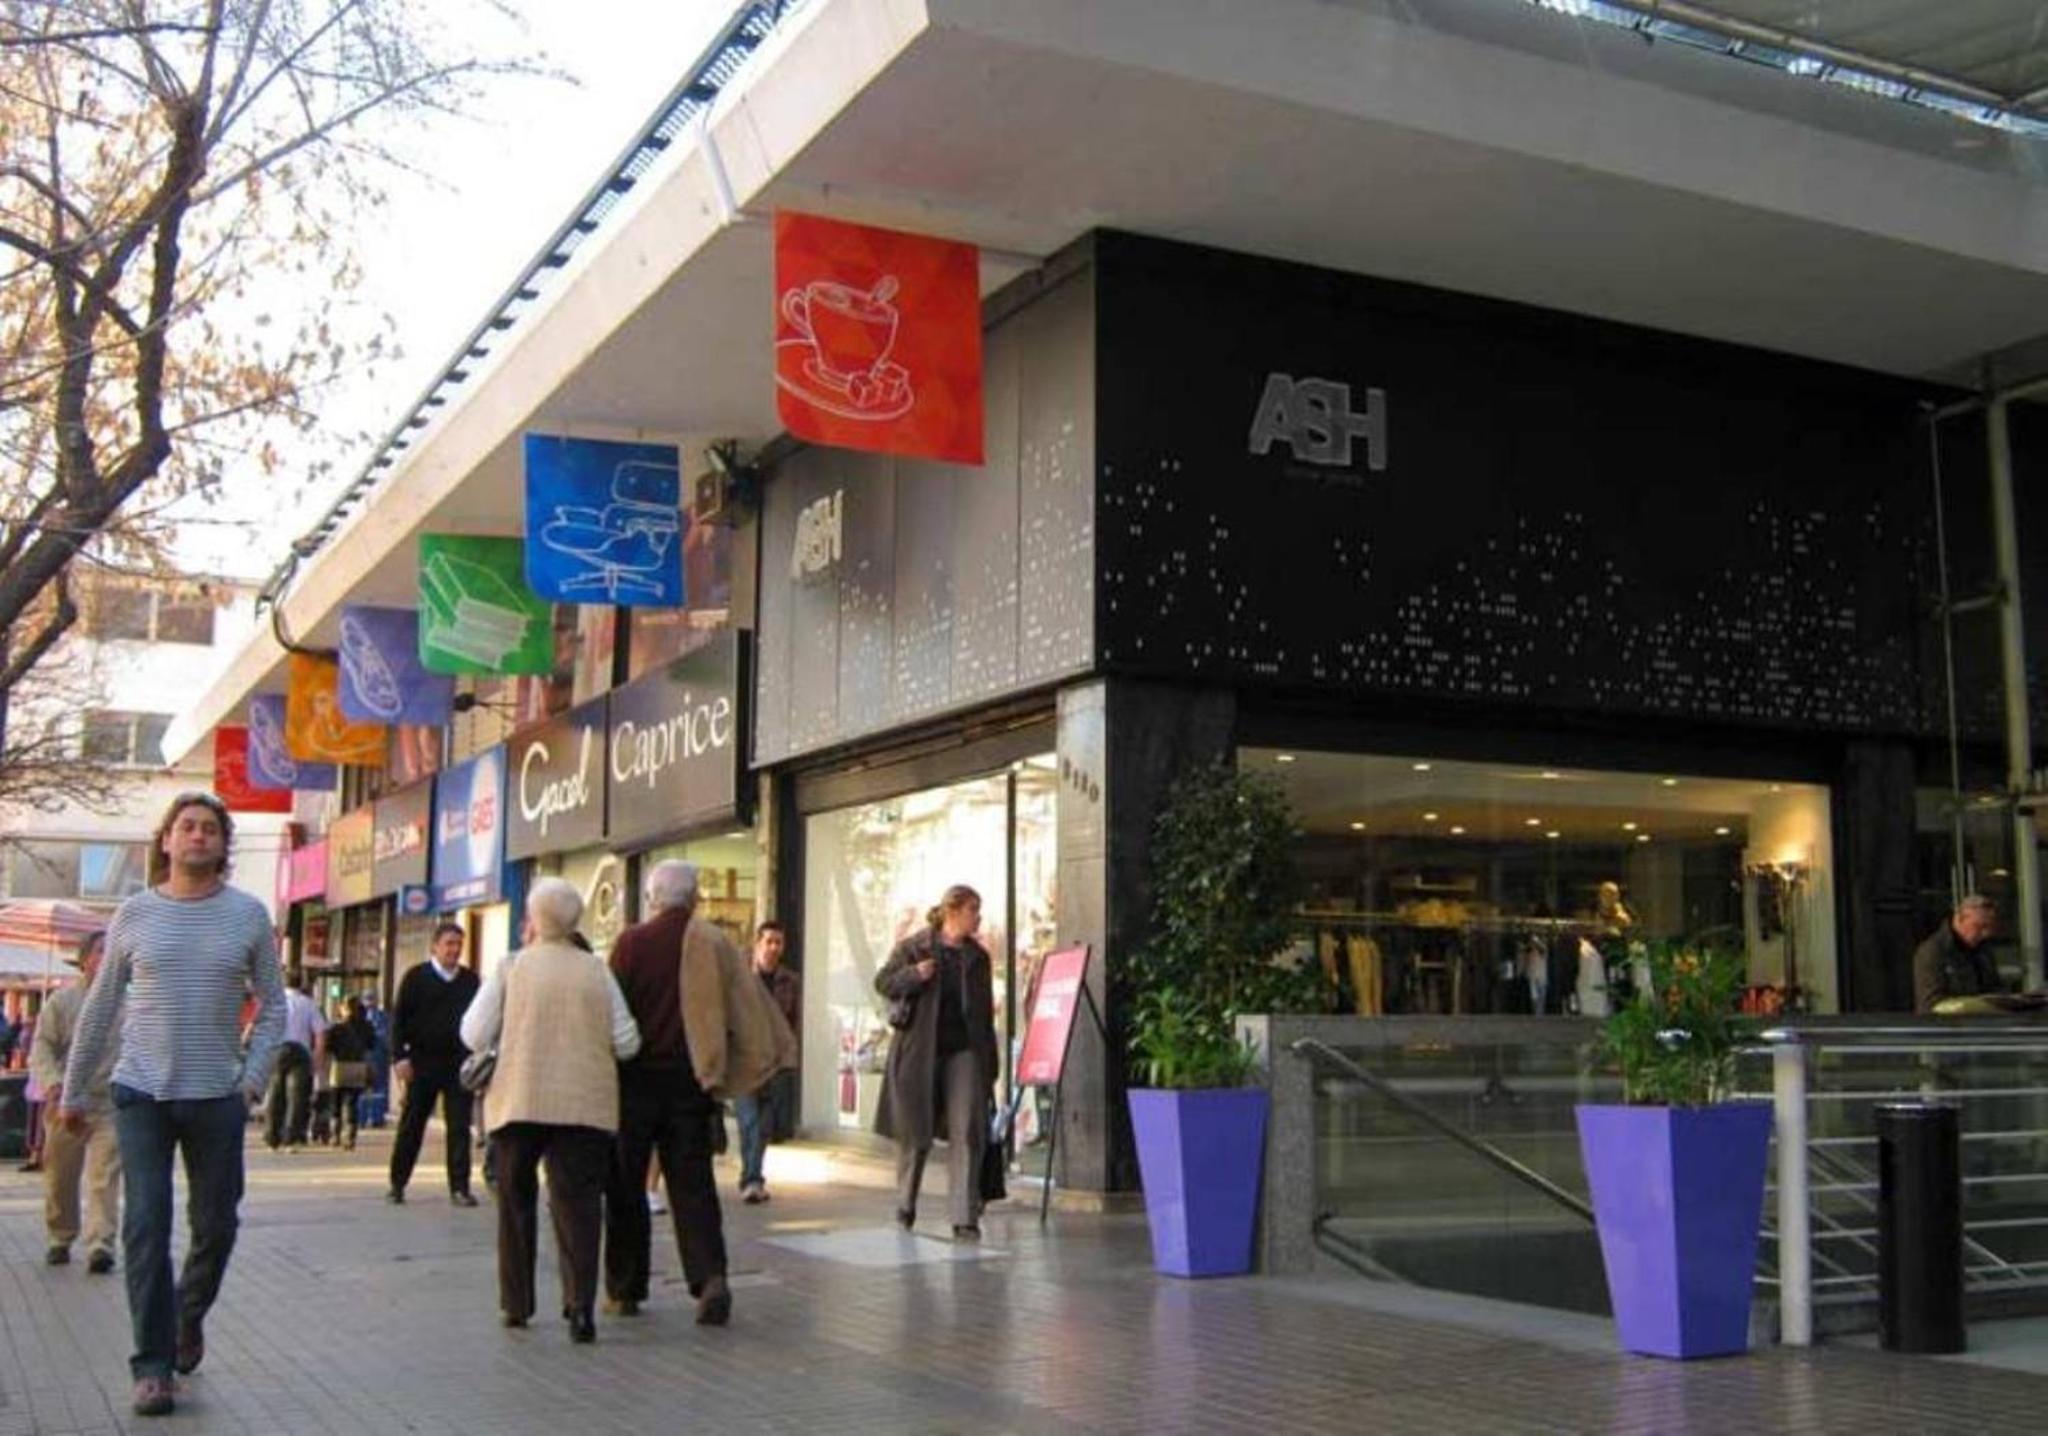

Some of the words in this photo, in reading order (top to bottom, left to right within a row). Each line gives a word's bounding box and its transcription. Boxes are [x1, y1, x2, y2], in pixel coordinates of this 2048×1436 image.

[1249, 373, 1387, 470] ASH
[791, 489, 843, 578] ASH
[611, 691, 730, 788] Caprice
